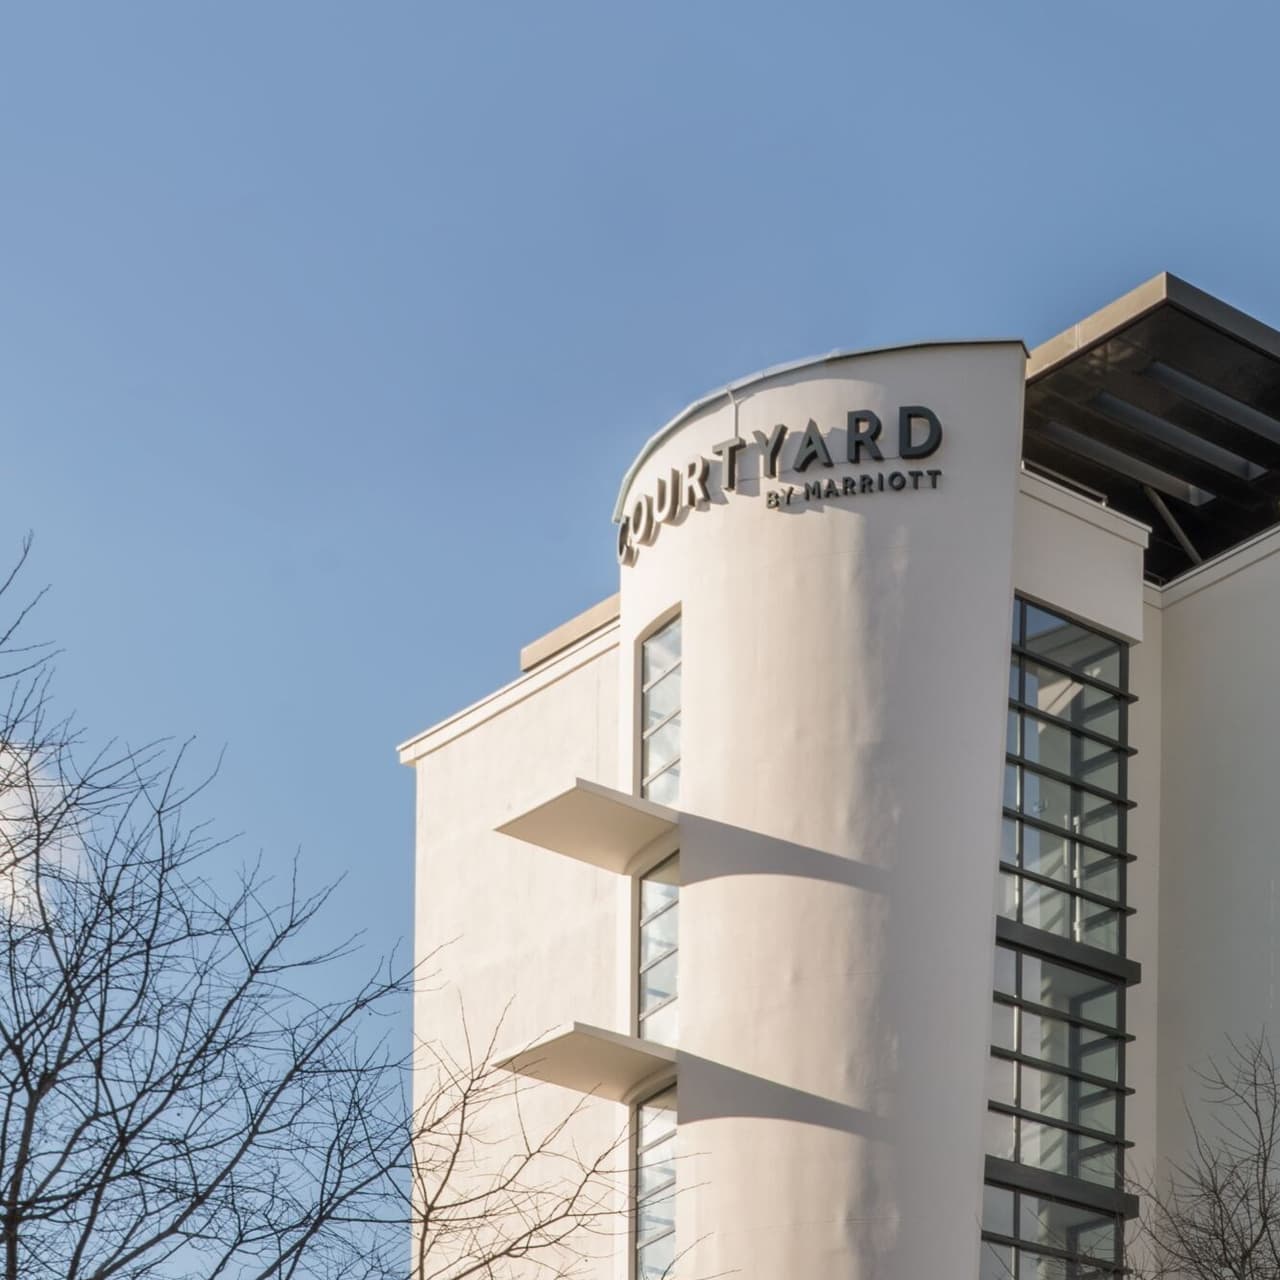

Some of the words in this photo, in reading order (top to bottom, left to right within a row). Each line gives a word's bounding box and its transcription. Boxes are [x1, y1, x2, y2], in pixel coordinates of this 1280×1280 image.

[617, 405, 943, 567] COURTYARD
[766, 486, 796, 509] BY
[804, 469, 943, 501] MARRIOTT
